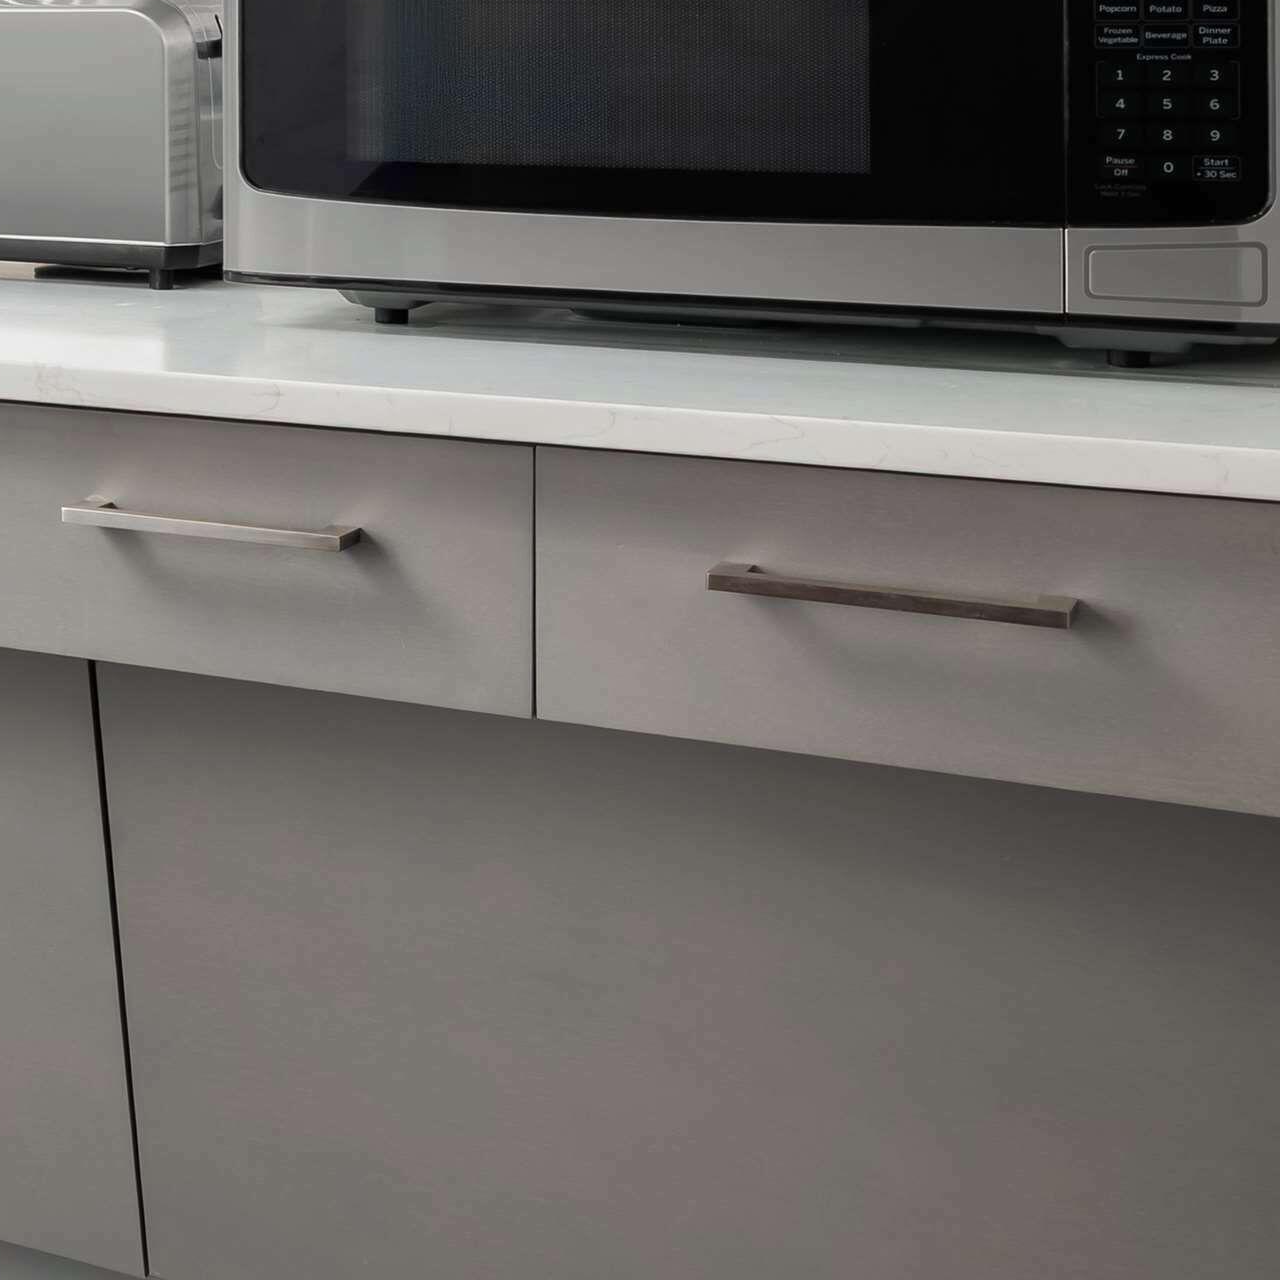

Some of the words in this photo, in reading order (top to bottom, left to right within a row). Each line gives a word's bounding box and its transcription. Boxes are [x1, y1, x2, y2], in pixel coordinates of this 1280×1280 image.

[1099, 4, 1137, 13] Popcorn
[1149, 5, 1182, 14] Potato
[1203, 4, 1228, 13] Pizza
[1104, 27, 1133, 35] Frozen
[1199, 26, 1232, 35] Dinner
[1098, 36, 1138, 44] Vegetable
[1145, 31, 1187, 40] Beverage
[1203, 36, 1228, 46] Plate
[1136, 53, 1169, 61] Express
[1170, 53, 1192, 61] Cook
[1116, 69, 1124, 81] 1
[1163, 69, 1172, 81] 2
[1210, 69, 1220, 81] 3
[1115, 98, 1126, 109] 4
[1162, 98, 1172, 109] 5
[1209, 98, 1220, 110] 6
[1116, 129, 1126, 139] 7
[1162, 129, 1173, 140] 8
[1210, 130, 1221, 141] 9
[1106, 156, 1135, 165] Pause
[1203, 158, 1229, 166] Start
[1163, 162, 1174, 173] 0
[1114, 168, 1128, 177] Off
[1205, 171, 1217, 179] 30
[1219, 171, 1237, 179] Sec
